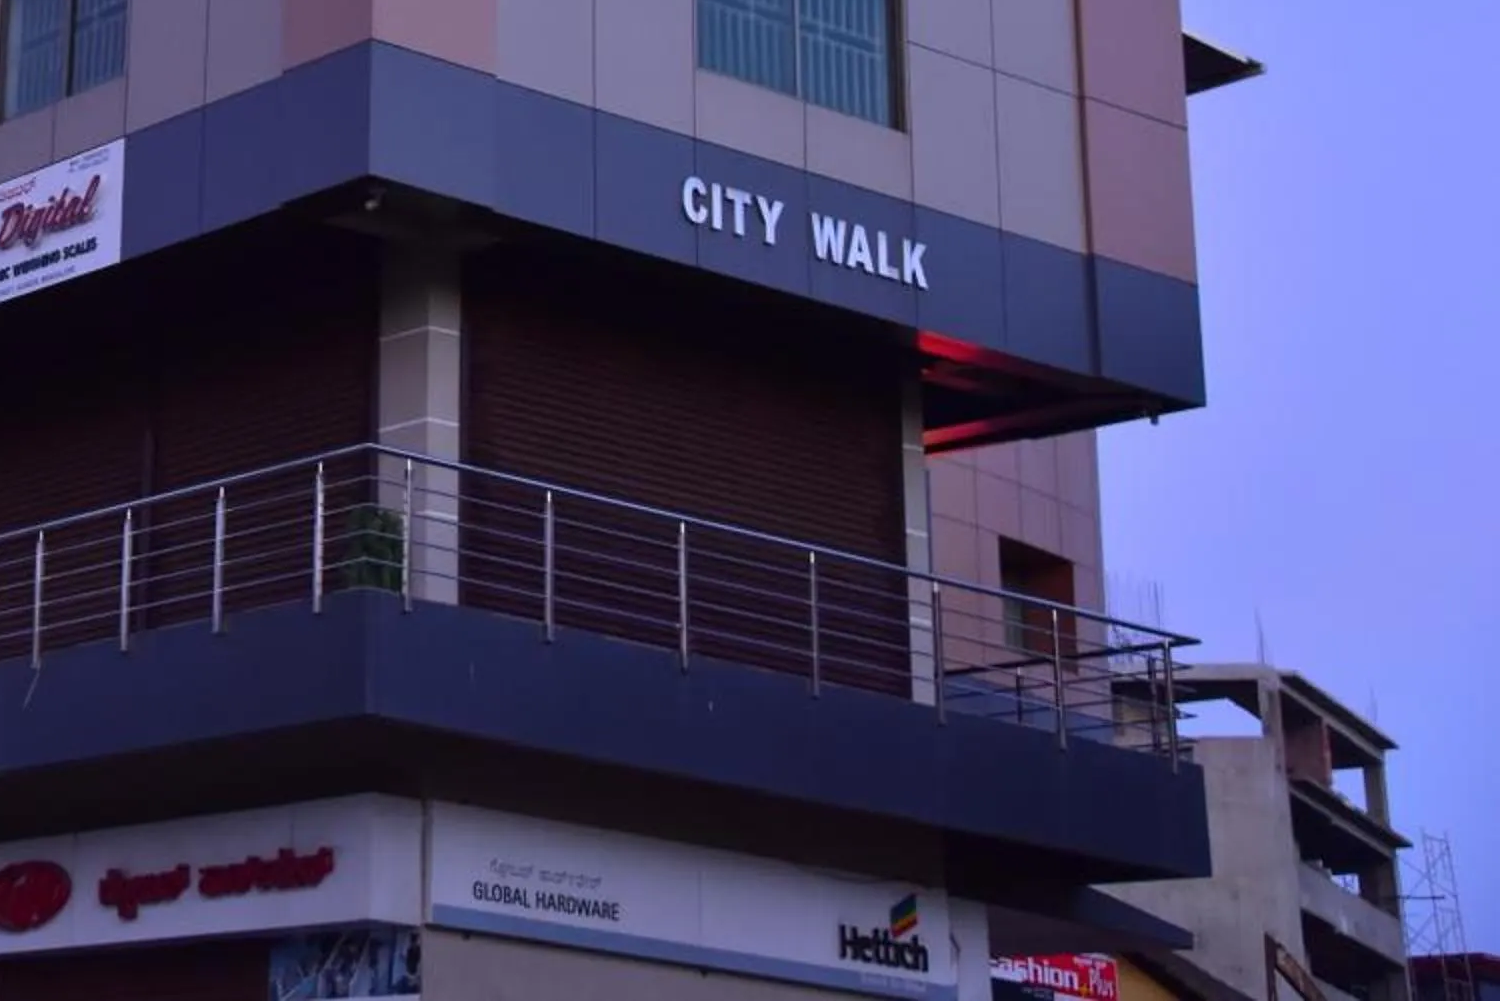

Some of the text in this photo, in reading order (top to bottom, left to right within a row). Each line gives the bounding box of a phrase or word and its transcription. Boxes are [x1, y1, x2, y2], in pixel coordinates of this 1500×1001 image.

[62, 236, 97, 260] SCALES
[682, 176, 930, 290] CITY WALK
[472, 879, 621, 921] GLOBAL HARDWARE
[839, 923, 929, 972] Hettich
